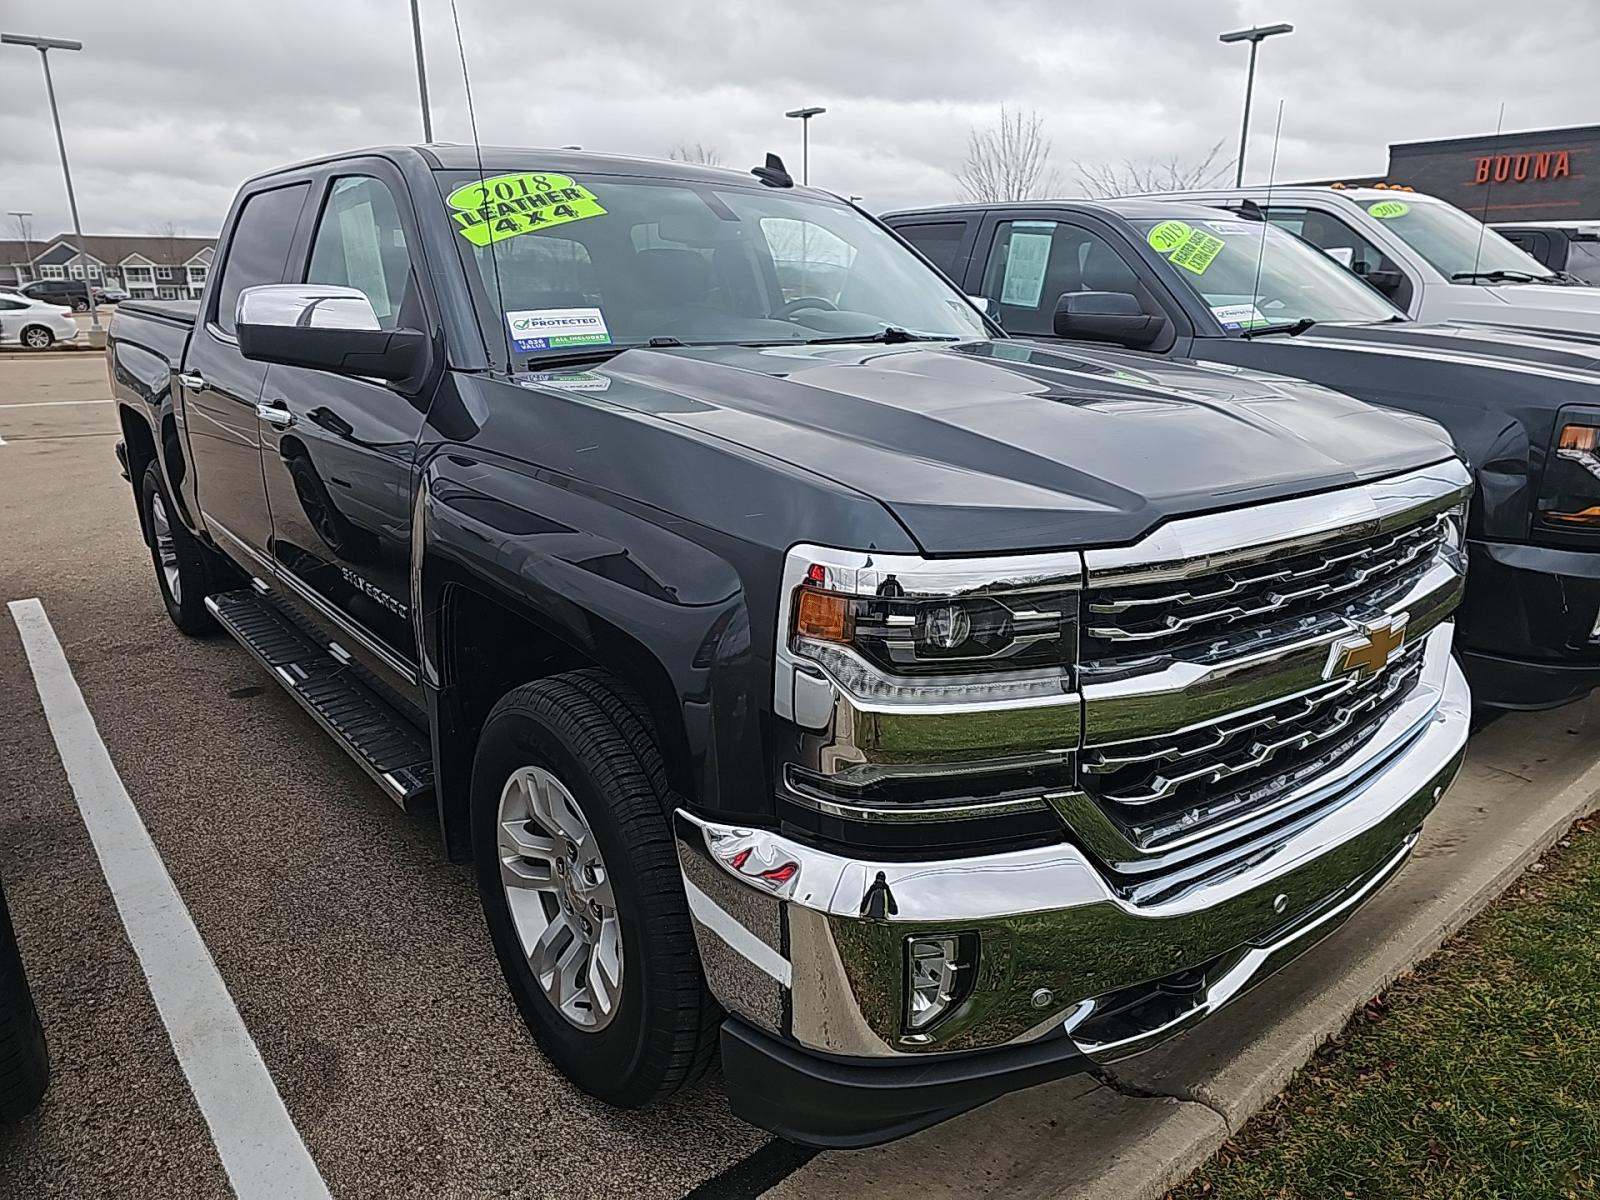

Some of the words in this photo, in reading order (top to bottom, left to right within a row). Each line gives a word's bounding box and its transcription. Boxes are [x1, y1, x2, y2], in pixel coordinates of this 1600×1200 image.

[1475, 151, 1569, 184] BOONA
[473, 175, 552, 207] 2018
[461, 187, 582, 226] LEATHER
[1155, 223, 1184, 248] 2019
[1188, 249, 1211, 270] EXTRA
[532, 318, 597, 327] PROTECTED
